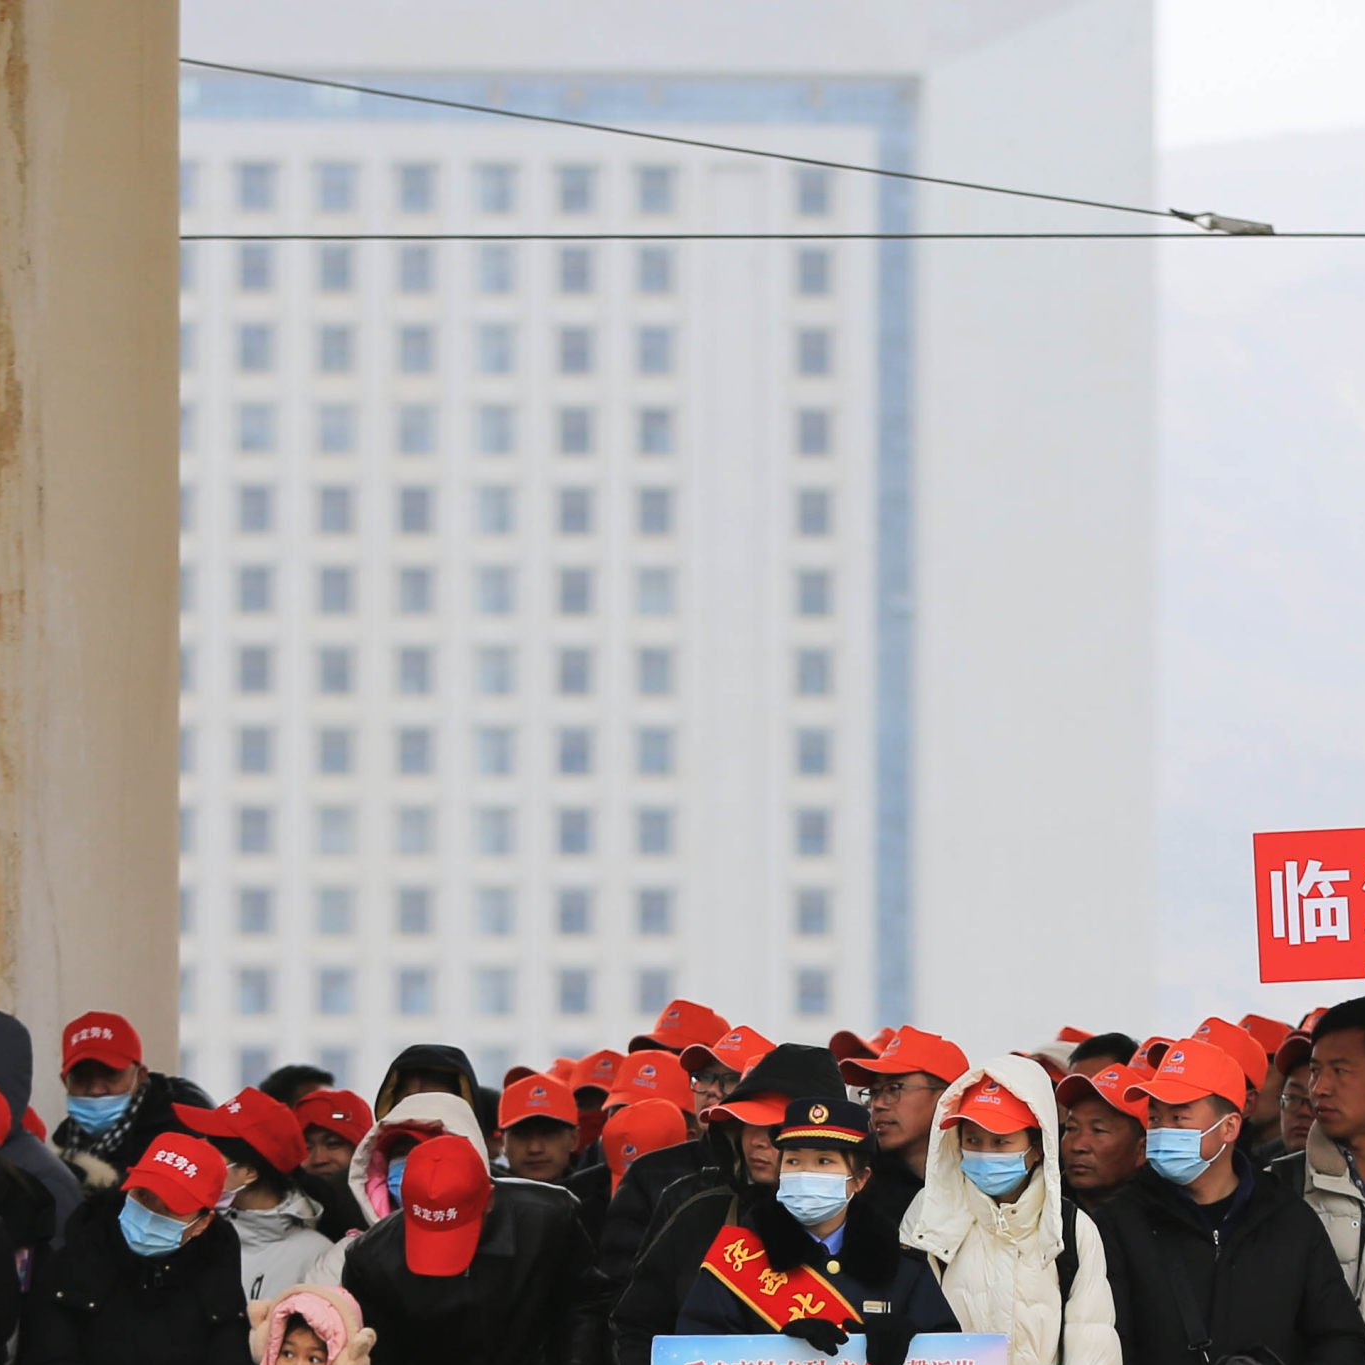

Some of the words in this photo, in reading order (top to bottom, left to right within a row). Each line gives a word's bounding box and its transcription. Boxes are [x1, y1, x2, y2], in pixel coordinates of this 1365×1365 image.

[153, 1149, 198, 1179] 安定劳务
[411, 1203, 459, 1222] 安定劳务
